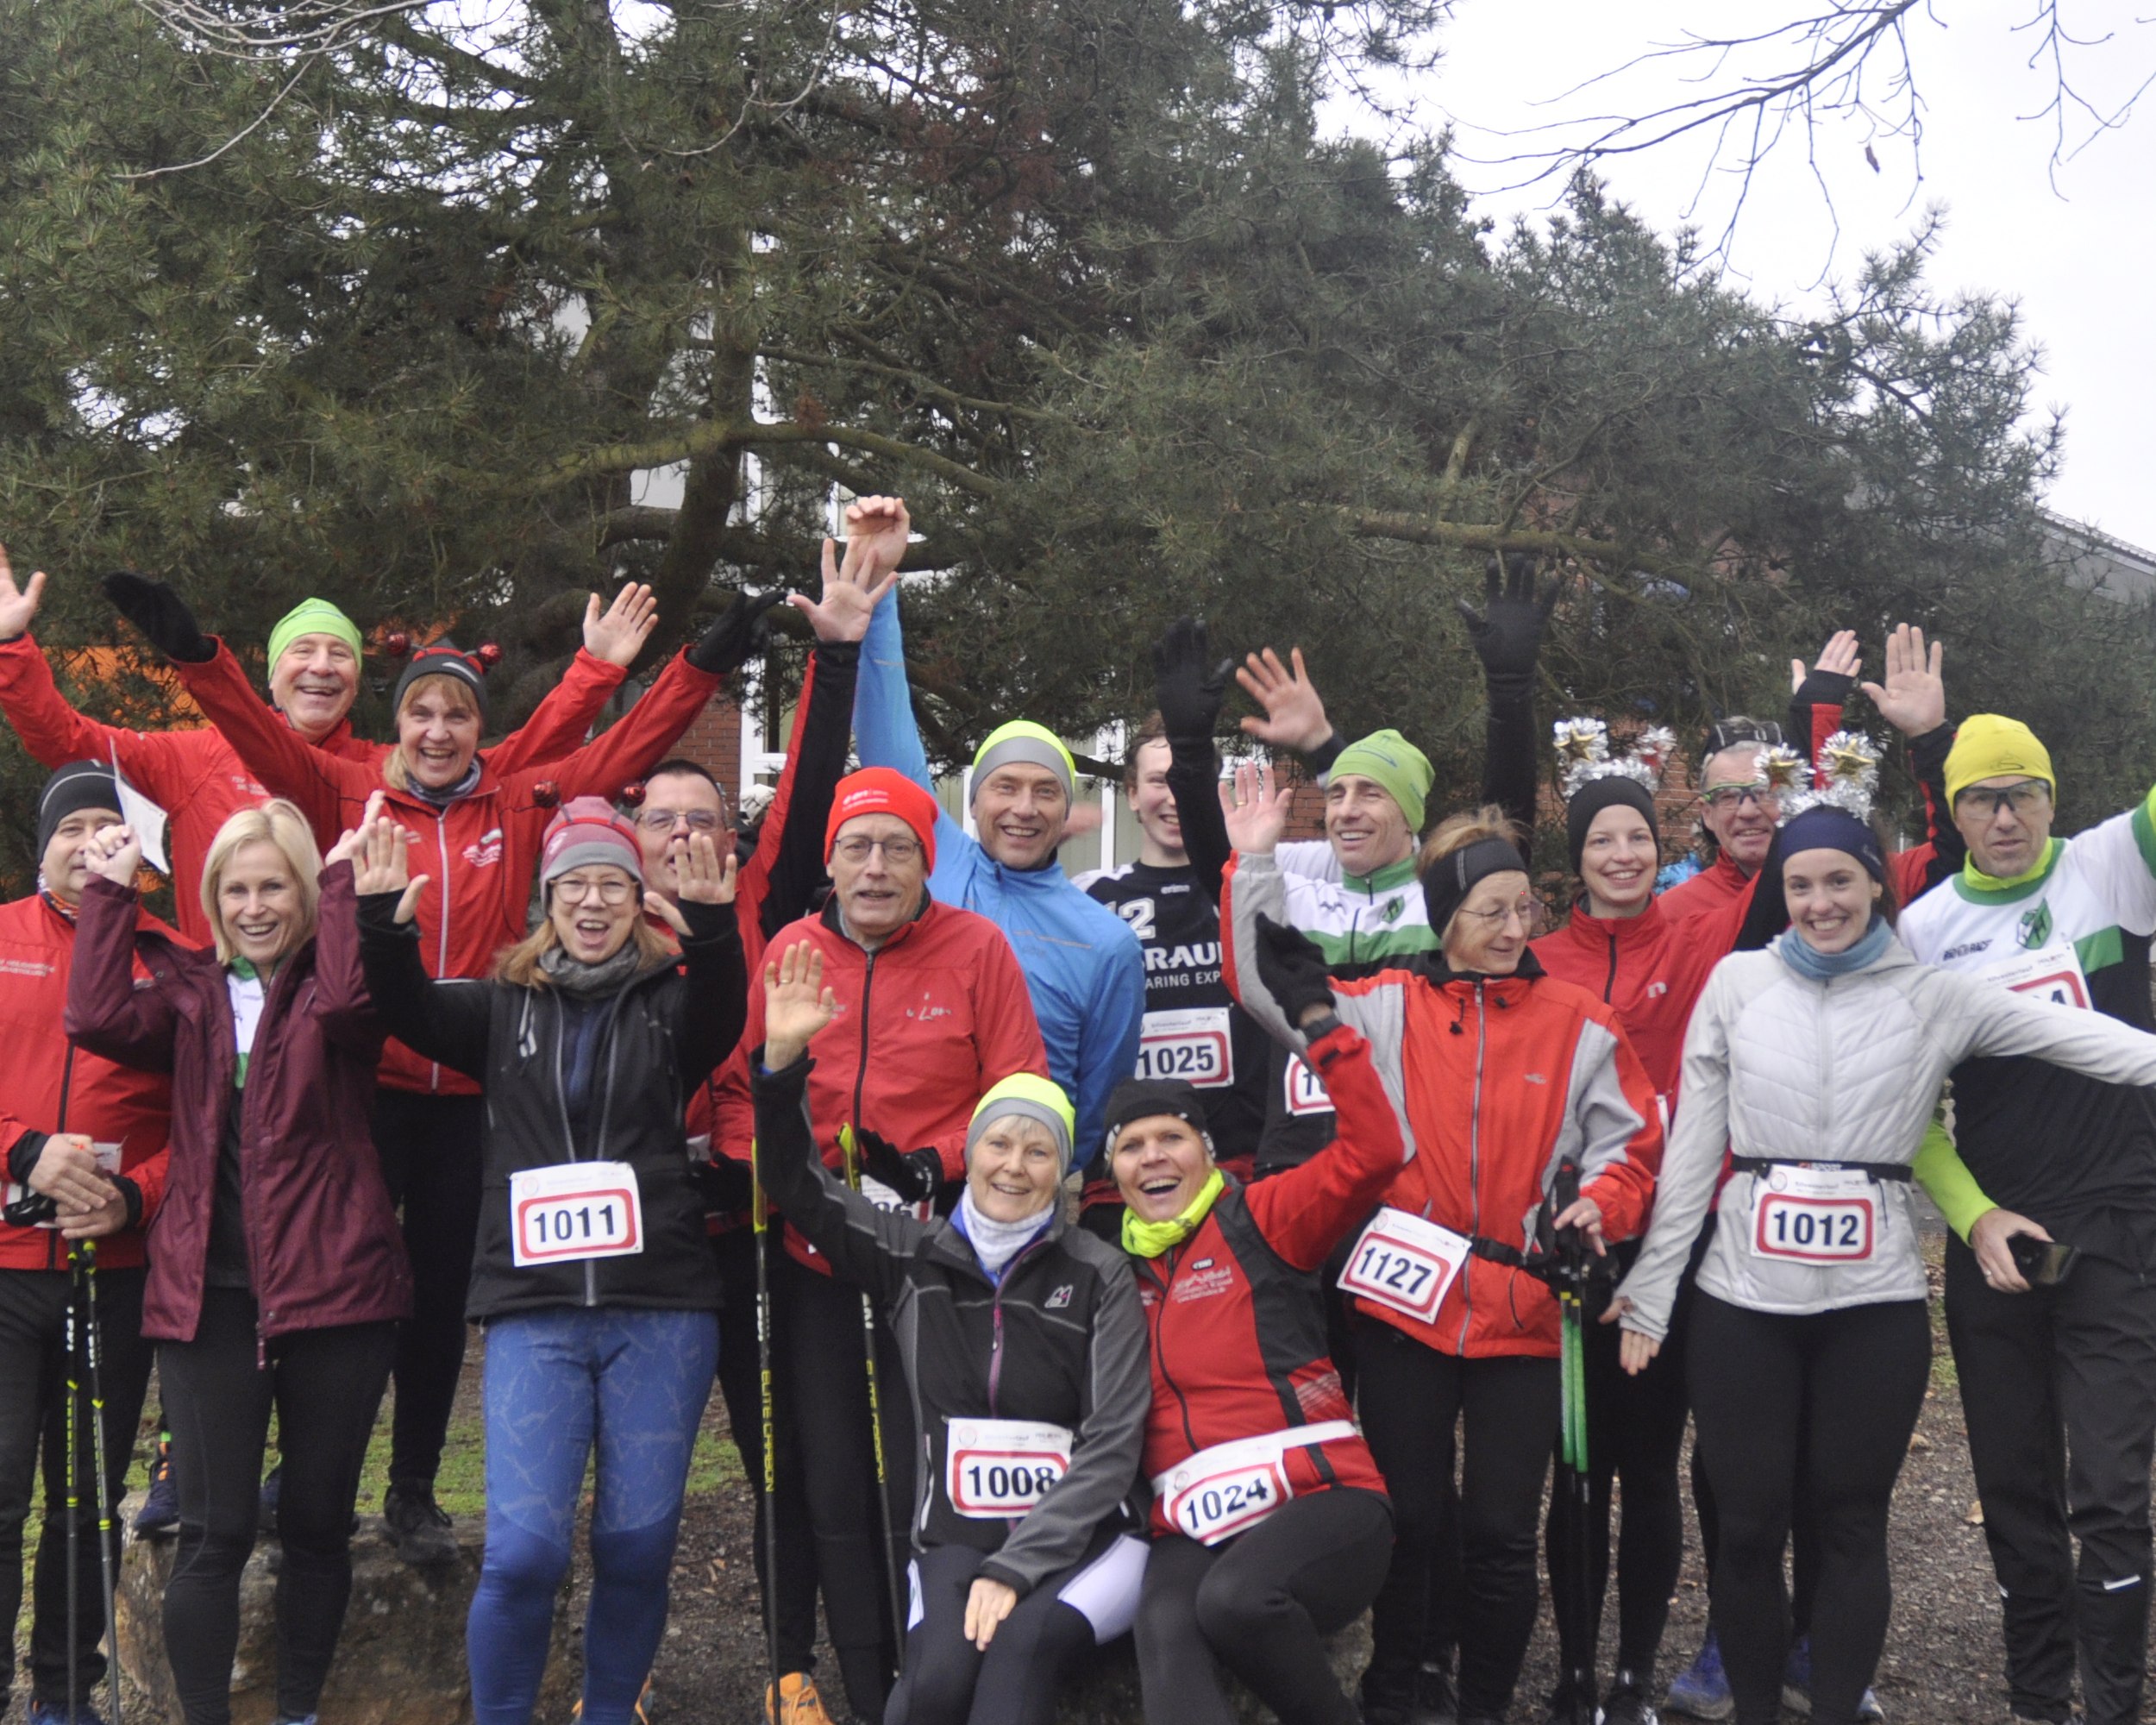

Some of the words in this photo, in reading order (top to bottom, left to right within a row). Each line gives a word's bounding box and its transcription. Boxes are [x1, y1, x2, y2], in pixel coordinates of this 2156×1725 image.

[1142, 941, 1223, 971] RAU
[1138, 1044, 1213, 1076] 1025
[534, 1204, 614, 1243] 1011
[1773, 1210, 1858, 1246] 1012
[1359, 1247, 1432, 1295] 1127
[968, 1465, 1056, 1498] 1008
[1186, 1477, 1269, 1531] 1024
